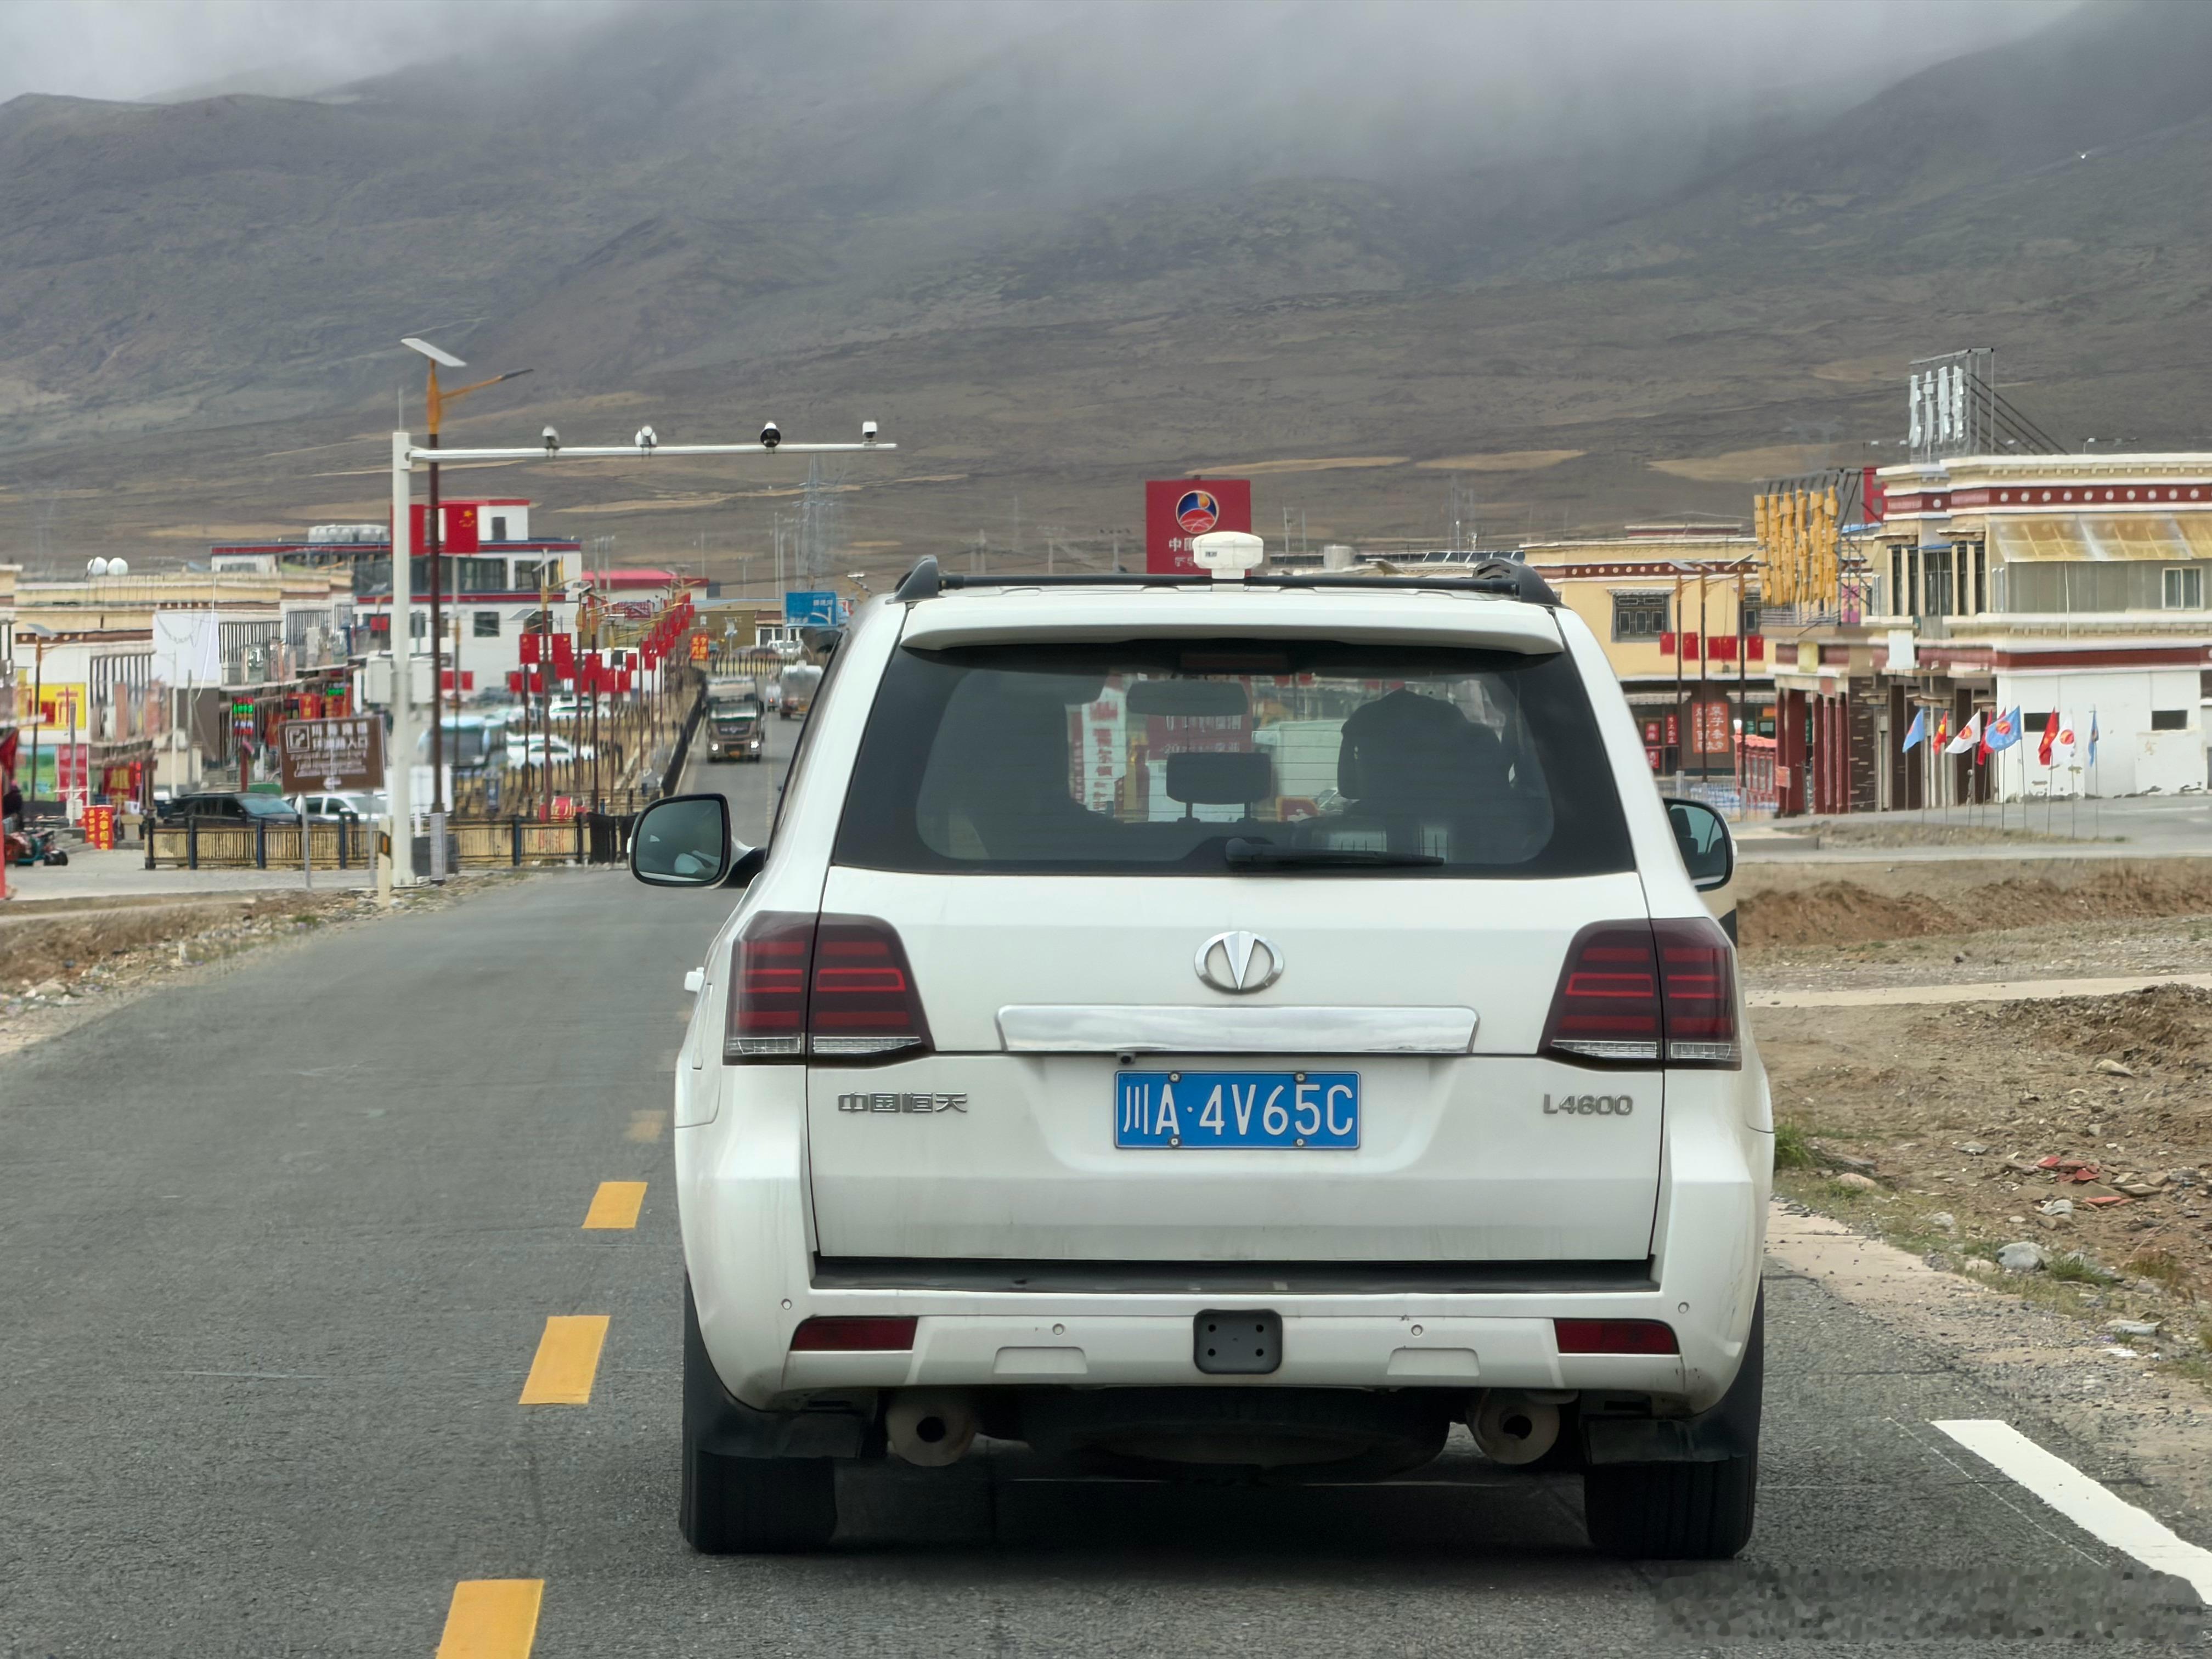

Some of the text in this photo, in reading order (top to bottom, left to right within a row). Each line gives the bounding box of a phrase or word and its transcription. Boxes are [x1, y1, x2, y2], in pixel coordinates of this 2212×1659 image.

[838, 1092, 967, 1113] 中国恒天
[1123, 1084, 1353, 1136] 川A·4V65C
[1543, 1094, 1633, 1115] L4600
